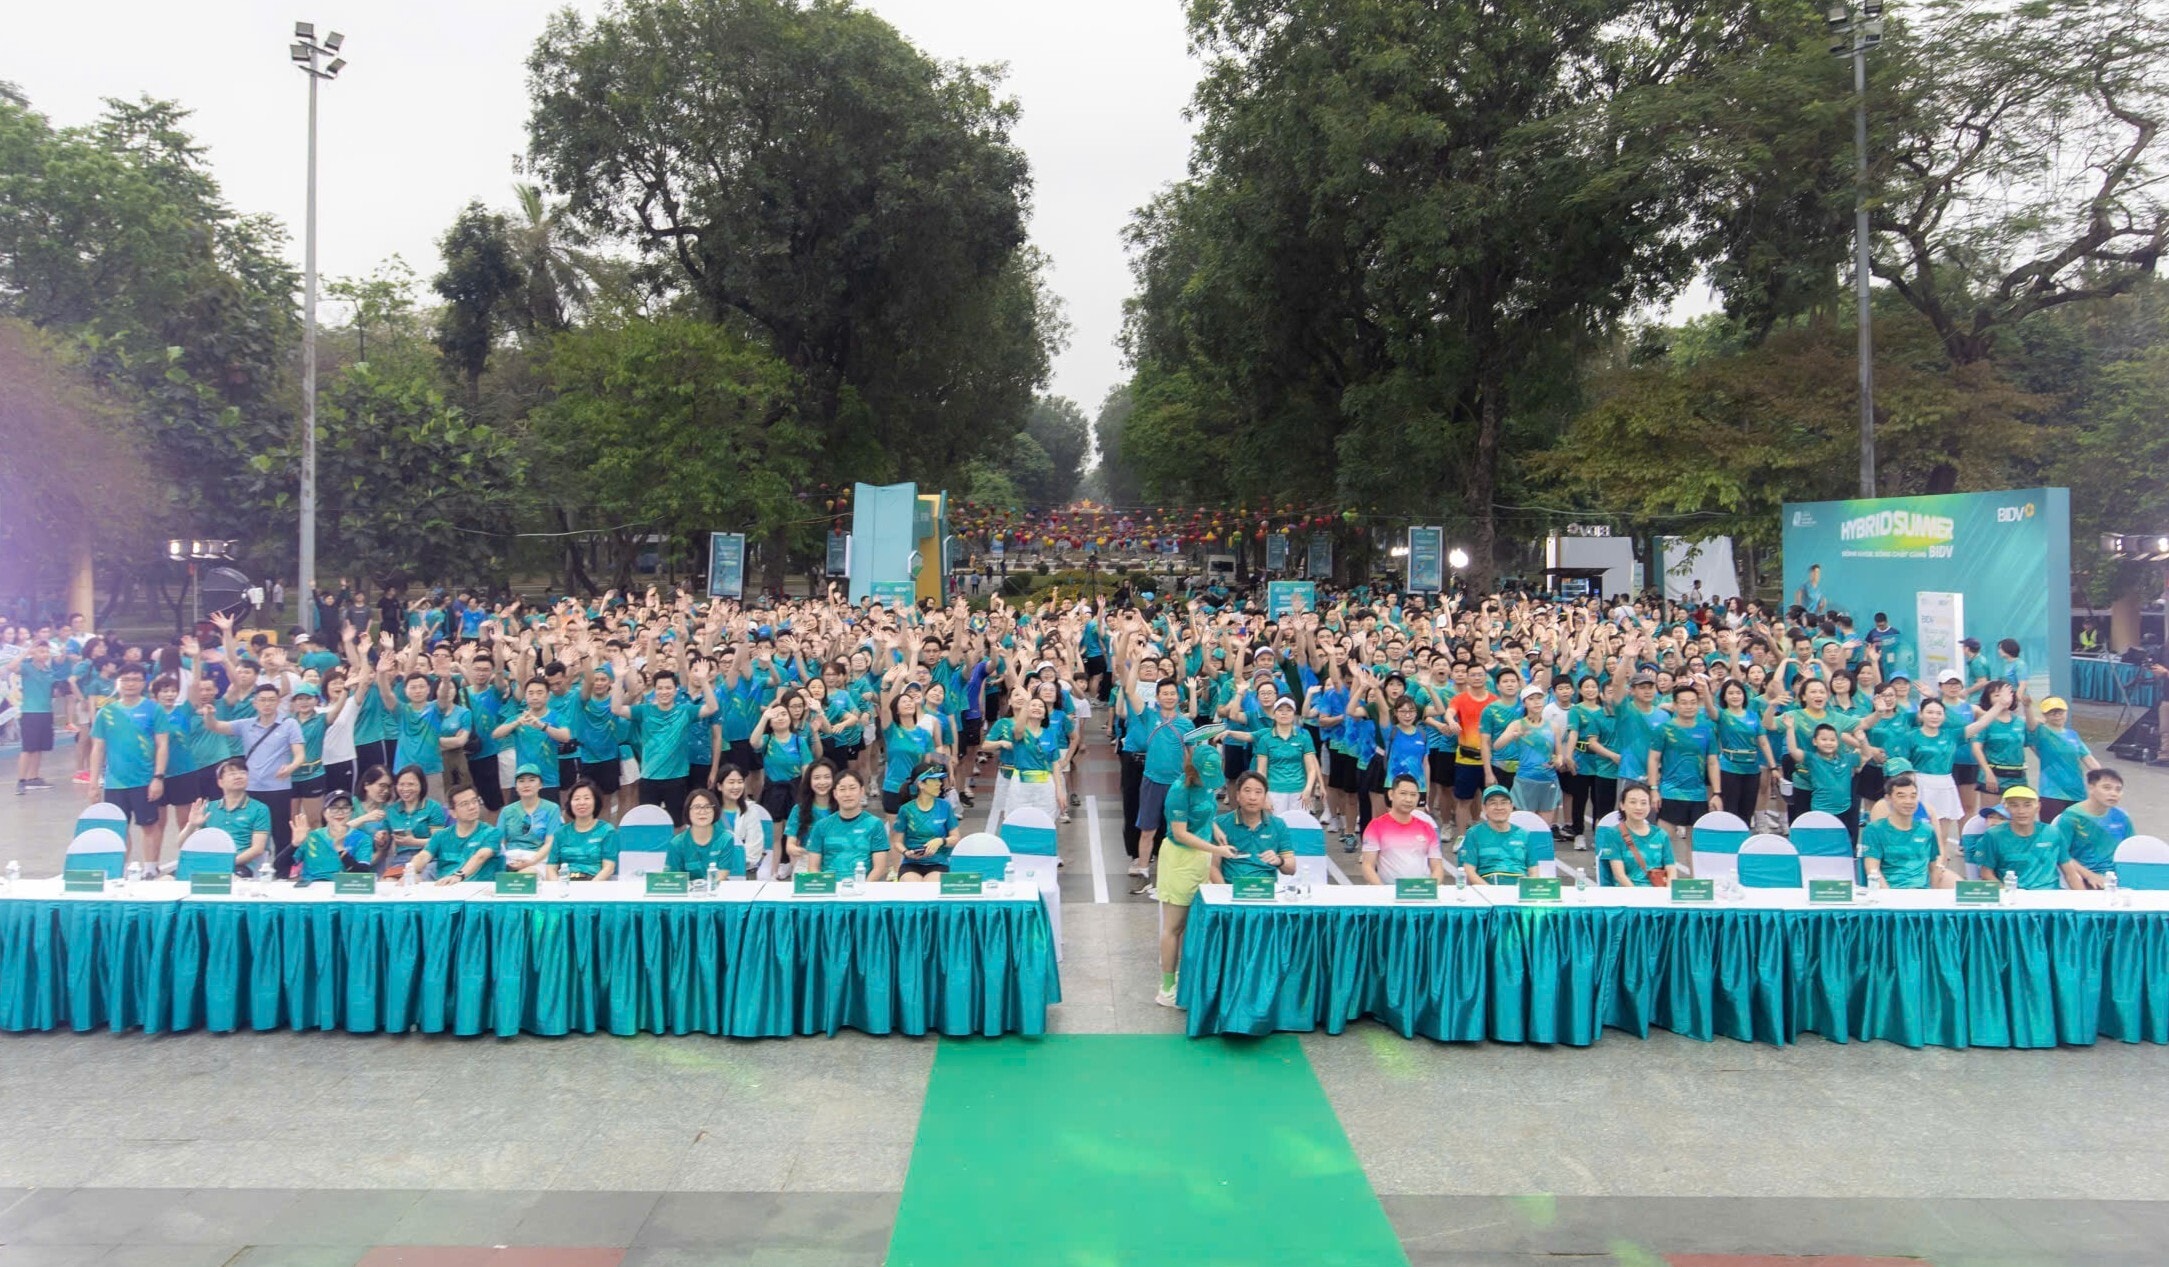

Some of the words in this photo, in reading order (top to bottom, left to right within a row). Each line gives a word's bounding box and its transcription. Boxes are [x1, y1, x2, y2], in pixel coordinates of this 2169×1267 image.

[1997, 506, 2024, 522] BIDV
[1841, 510, 1892, 540] HYBRID
[1928, 545, 1954, 558] BIDV
